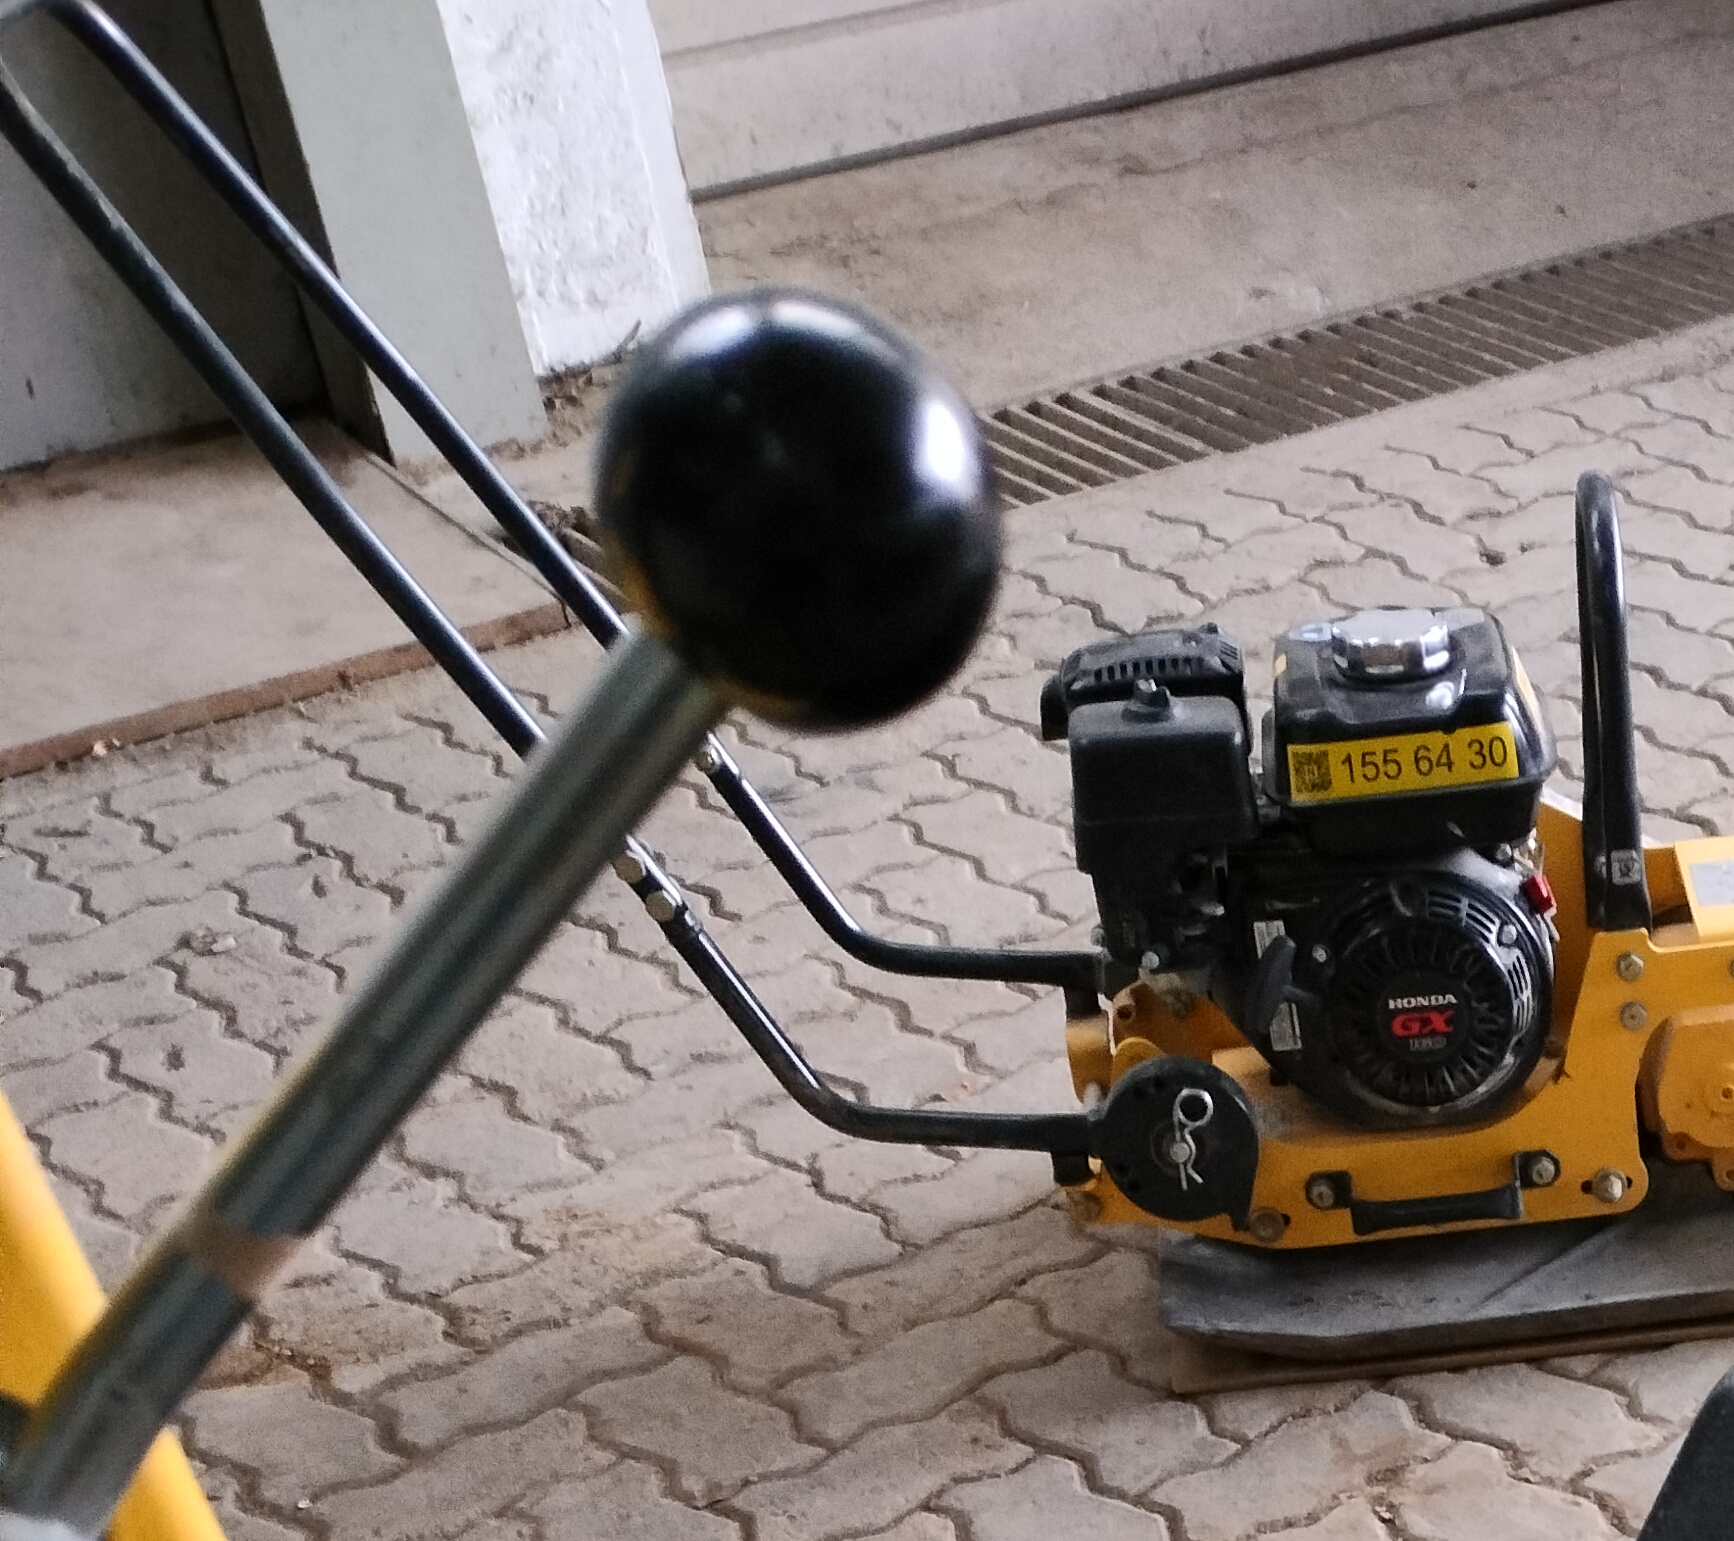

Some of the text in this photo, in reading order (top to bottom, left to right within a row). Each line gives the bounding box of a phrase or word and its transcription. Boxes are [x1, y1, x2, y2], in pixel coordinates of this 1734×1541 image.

[1341, 736, 1508, 783] 155 64 30
[1388, 994, 1458, 1009] HONDA
[1391, 1010, 1455, 1037] GX
